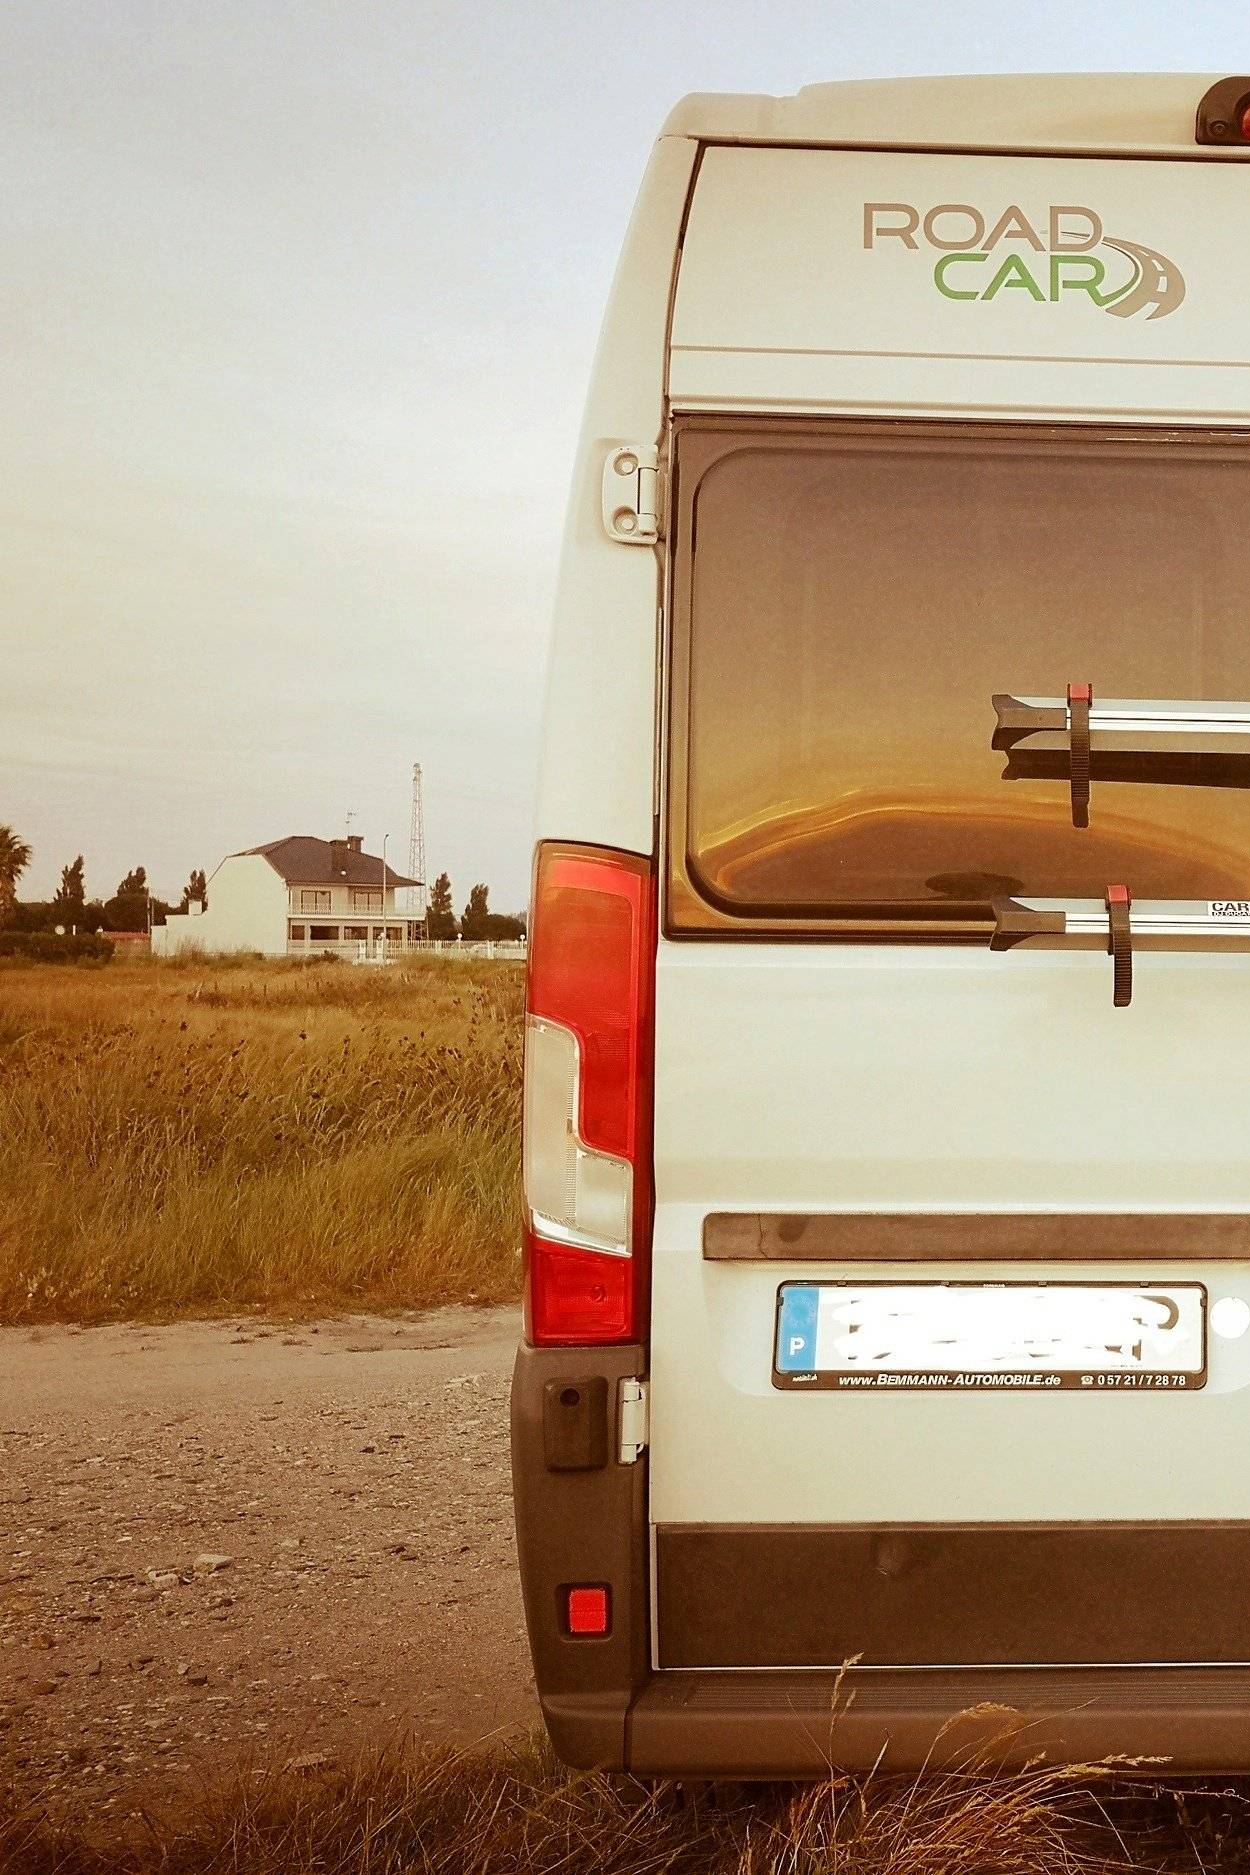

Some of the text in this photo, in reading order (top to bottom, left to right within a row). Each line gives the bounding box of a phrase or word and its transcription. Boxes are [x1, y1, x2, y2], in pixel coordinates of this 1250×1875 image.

[863, 202, 1103, 253] ROAD
[933, 252, 1108, 306] CAR
[789, 1337, 806, 1356] P
